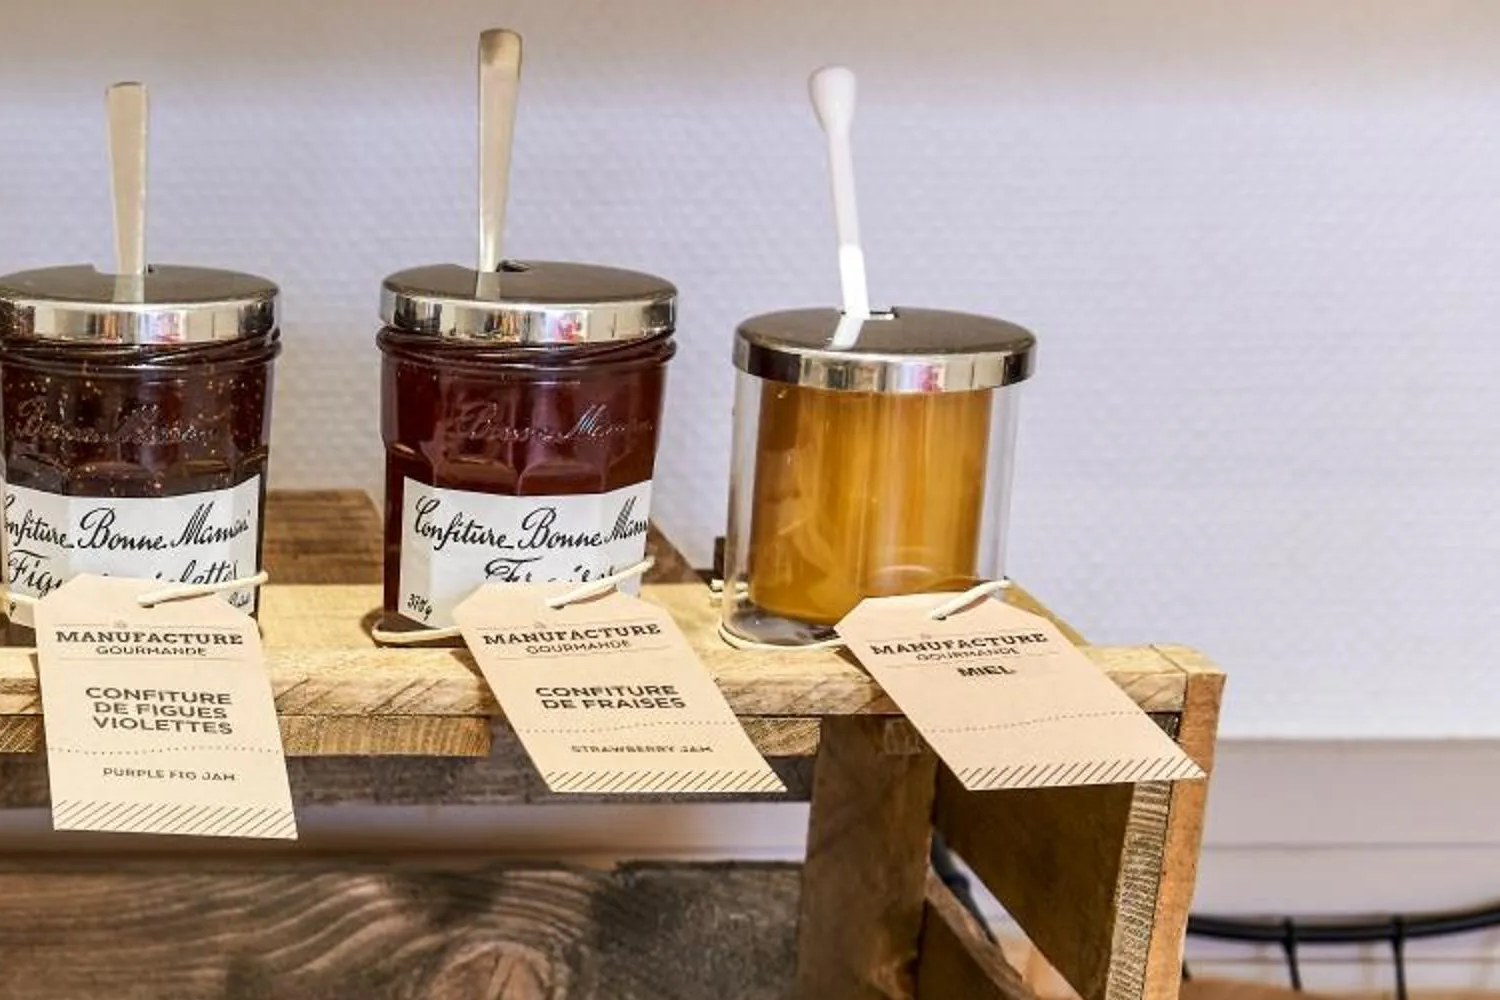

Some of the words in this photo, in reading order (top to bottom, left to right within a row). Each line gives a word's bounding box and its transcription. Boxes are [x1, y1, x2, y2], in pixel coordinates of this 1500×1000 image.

[77, 507, 167, 551] Bonne
[415, 496, 514, 550] Confiture
[517, 507, 603, 550] Bonne
[55, 630, 243, 645] MANUFACTURE
[483, 623, 661, 645] MANUFACTURE
[95, 645, 207, 656] GOURMANDE
[526, 639, 632, 655] GOURMANDE
[870, 633, 1049, 655] MANUFACTURE
[916, 647, 1020, 661] GOURMANDE
[957, 664, 1015, 677] MIEL
[85, 686, 233, 705] CONFITURE
[535, 685, 678, 698] CONFITURE
[94, 702, 129, 715] DE
[136, 703, 227, 719] FIGUES
[541, 699, 577, 709] DE
[581, 698, 686, 709] FRAISES
[93, 716, 233, 735] VIOLETTES
[571, 745, 675, 753] STRAWBERRY
[680, 745, 713, 753] JAM
[103, 767, 165, 780] PURPLE
[169, 771, 197, 781] FIG
[202, 771, 235, 782] JAM
